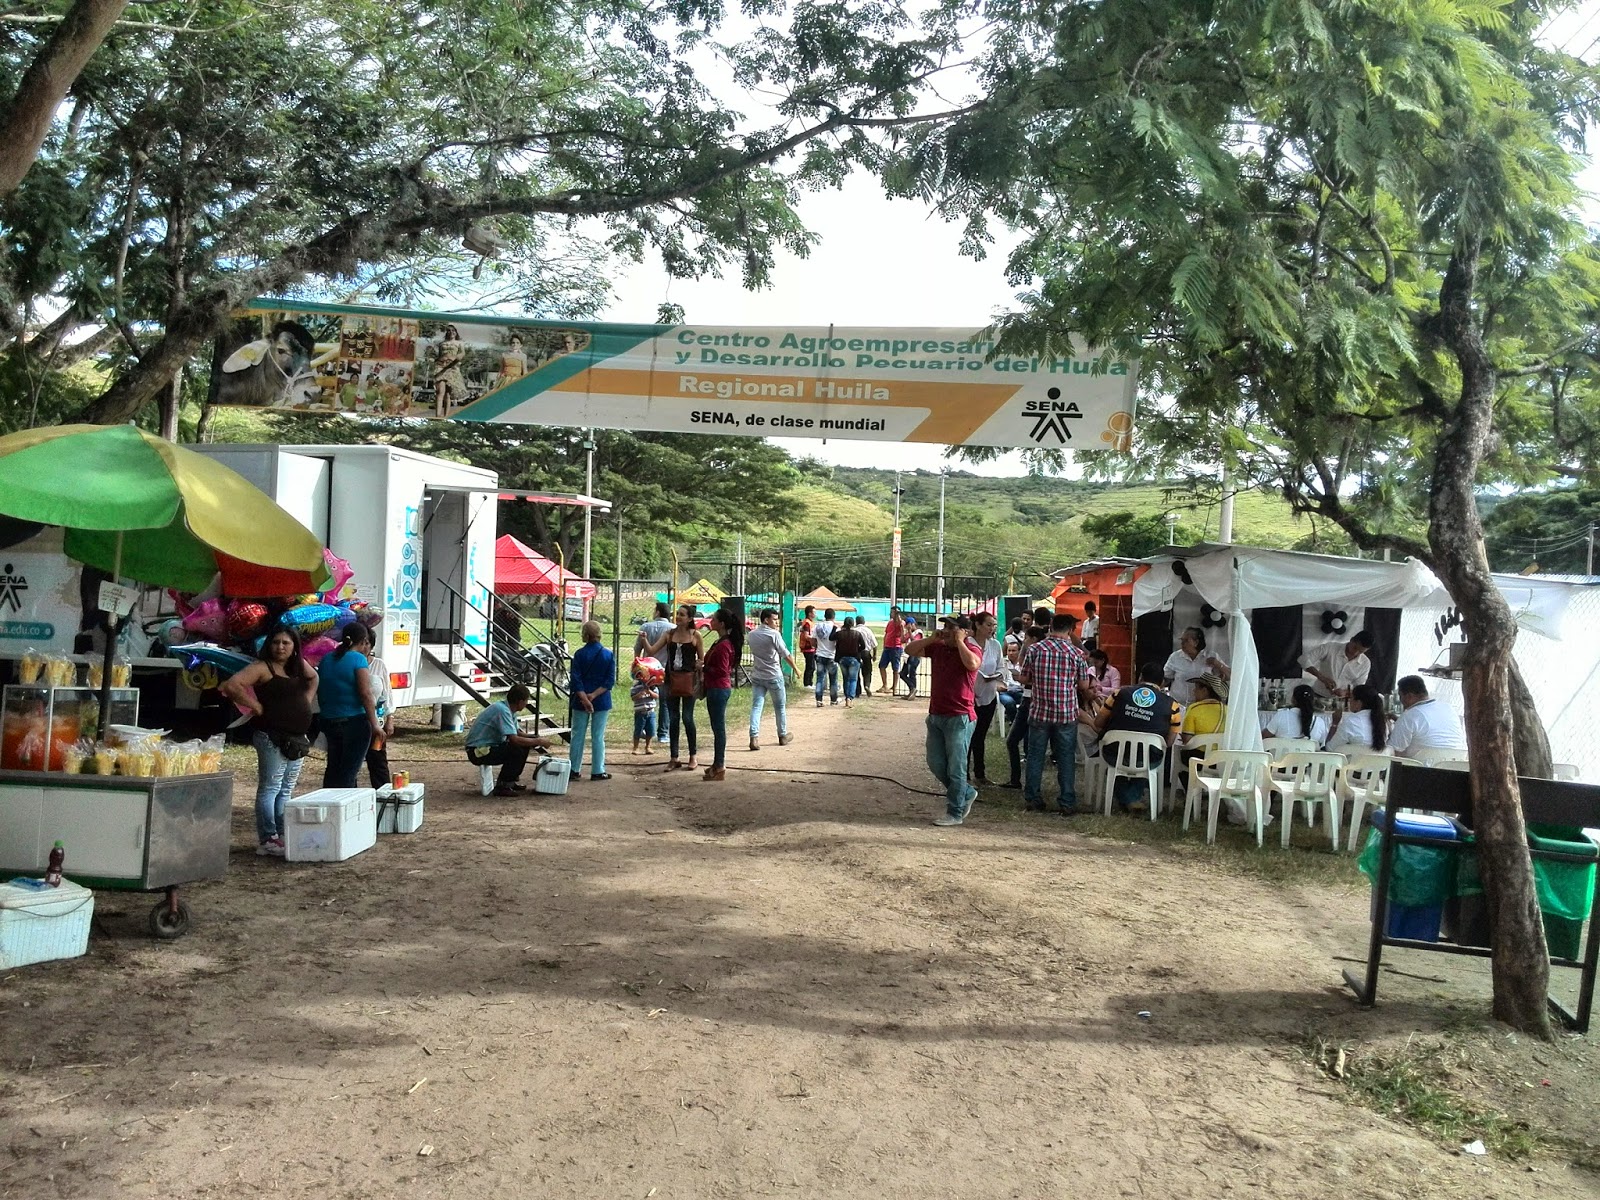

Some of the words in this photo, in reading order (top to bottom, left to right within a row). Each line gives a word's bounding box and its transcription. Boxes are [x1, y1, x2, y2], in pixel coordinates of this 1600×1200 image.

[677, 329, 771, 348] Centro
[779, 332, 998, 357] Agroempresari
[674, 350, 692, 365] y
[700, 348, 846, 368] Desarrollo
[855, 353, 984, 371] Pecuario
[993, 357, 1039, 373] del
[679, 375, 804, 398] Regional
[814, 381, 891, 401] Huila
[1025, 400, 1080, 412] SENA
[690, 410, 740, 428] SENA,
[745, 413, 765, 426] de
[770, 415, 815, 428] clase
[819, 419, 886, 431] mundial
